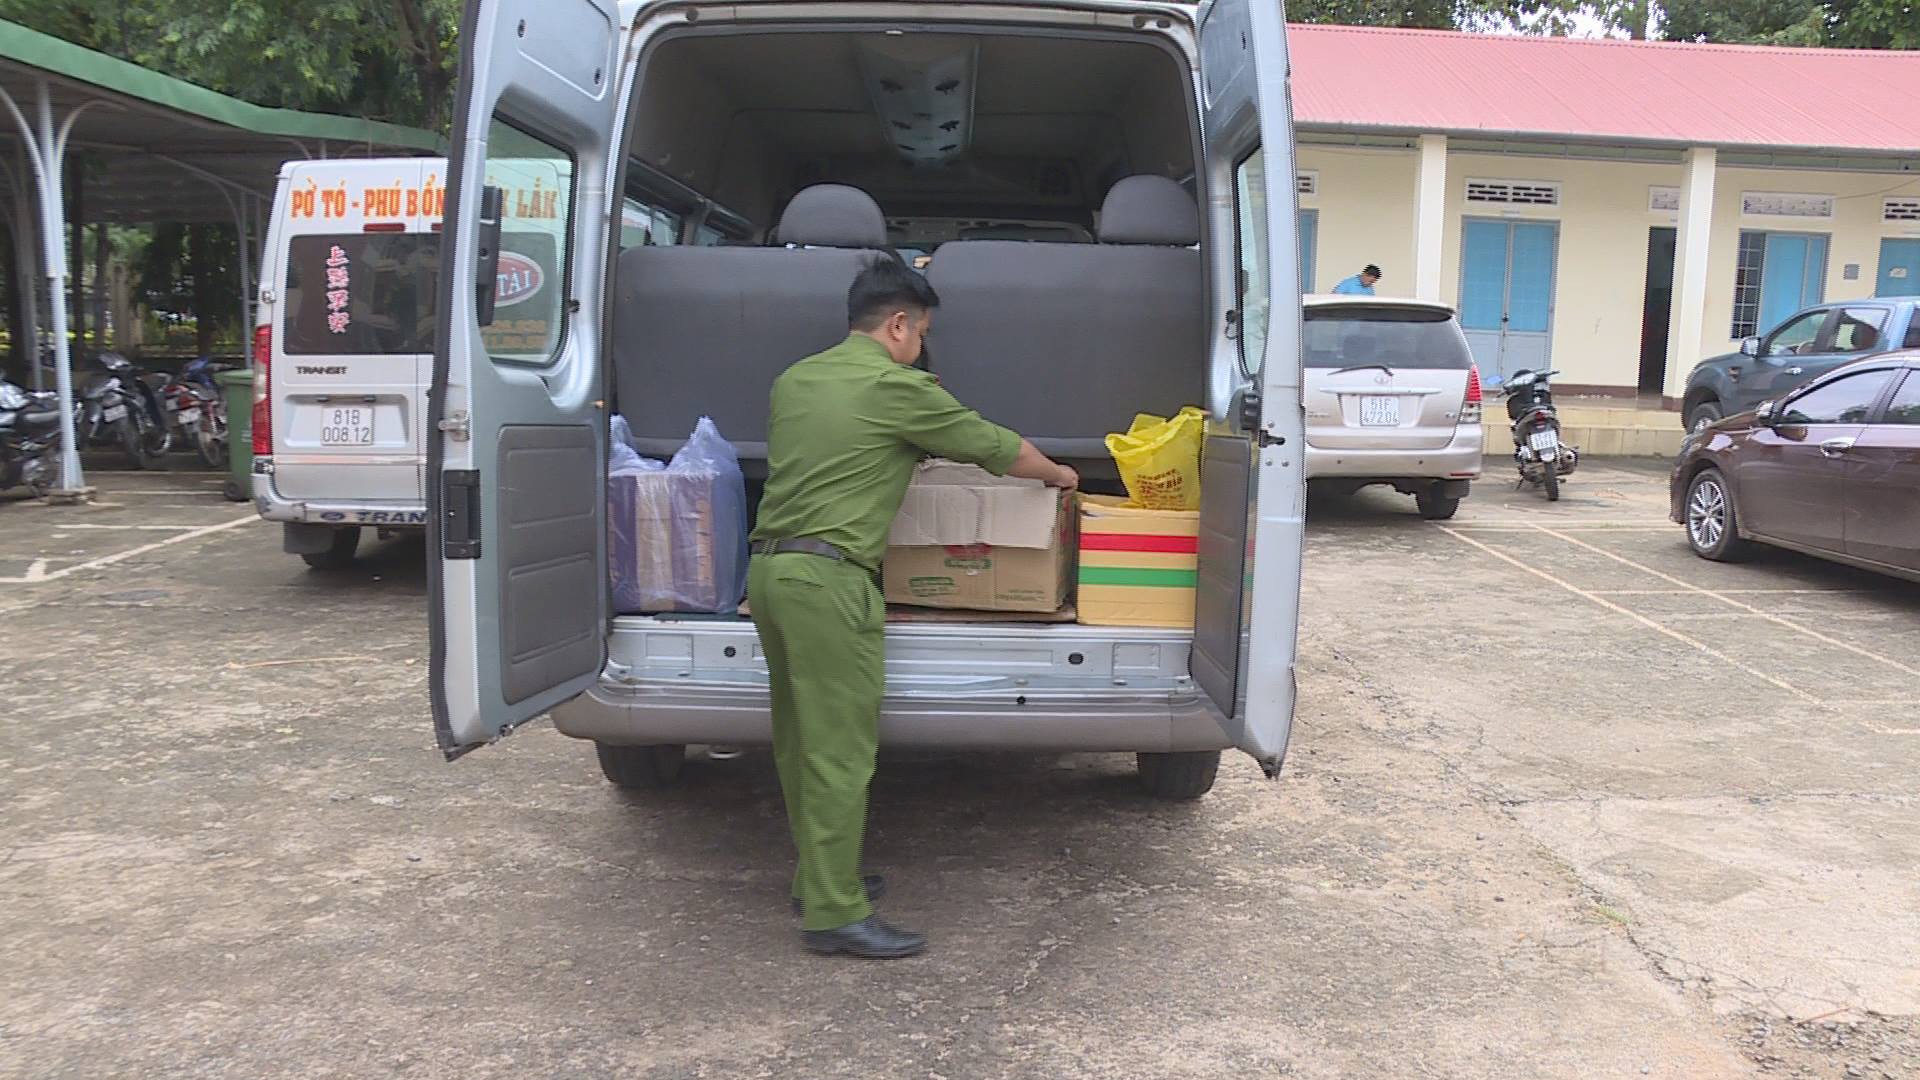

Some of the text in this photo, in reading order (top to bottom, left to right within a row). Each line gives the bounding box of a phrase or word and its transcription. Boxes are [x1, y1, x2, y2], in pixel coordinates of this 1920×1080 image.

[321, 179, 346, 218] TÓ
[363, 179, 401, 217] PHÚ
[295, 366, 348, 375] TRANSIT
[333, 409, 361, 426] 81B
[322, 426, 370, 443] 008.12
